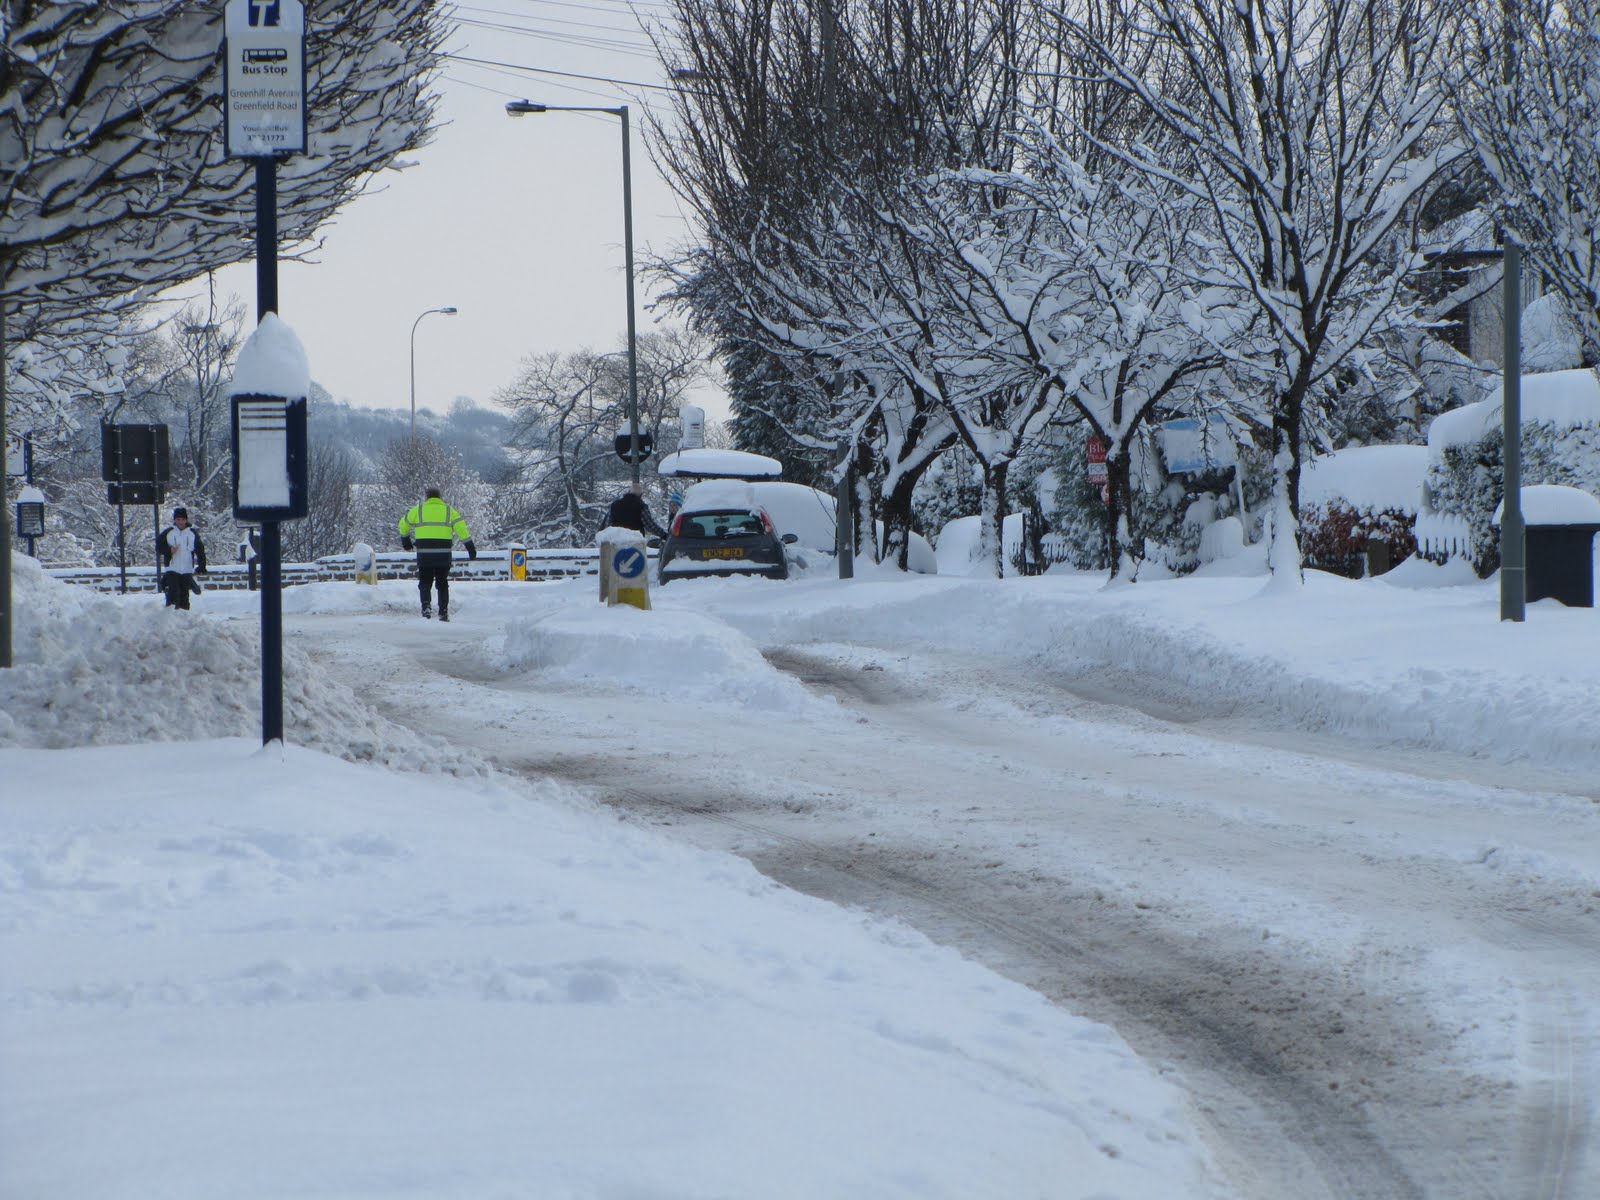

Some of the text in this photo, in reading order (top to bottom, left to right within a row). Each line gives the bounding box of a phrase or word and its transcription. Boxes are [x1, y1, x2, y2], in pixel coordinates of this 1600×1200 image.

[242, 65, 288, 76] Bus Stop
[230, 89, 266, 98] Greenhill
[233, 101, 298, 111] Greenfield Road
